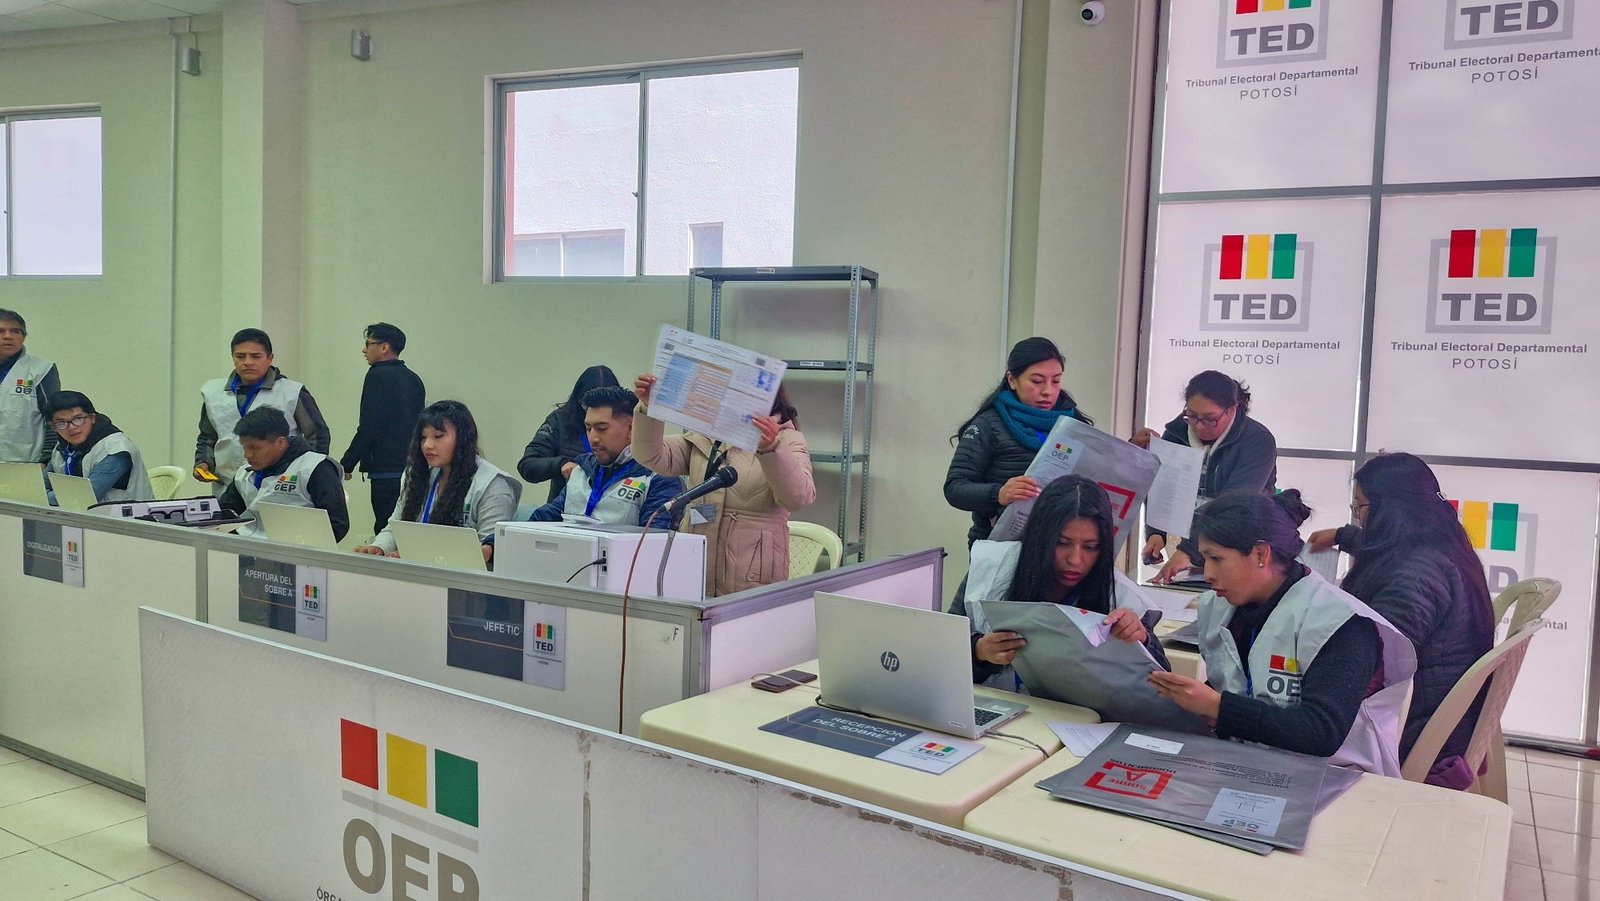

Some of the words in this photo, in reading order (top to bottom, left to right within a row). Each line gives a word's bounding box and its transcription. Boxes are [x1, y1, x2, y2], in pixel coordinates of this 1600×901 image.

[1460, 0, 1559, 36] TED
[1230, 22, 1315, 55] TED
[1409, 58, 1456, 71] Tribunal
[1460, 54, 1513, 67] Electoral
[1186, 76, 1227, 88] Tribunal
[1230, 72, 1276, 84] Electoral
[1279, 66, 1359, 81] Departamental
[1471, 66, 1538, 83] POTOSÍ
[1240, 84, 1298, 100] POTOSÍ
[1213, 293, 1297, 320] TED
[1441, 293, 1538, 322] TED
[1169, 338, 1210, 348] Tribunal
[1213, 339, 1259, 349] Electoral
[1262, 339, 1341, 350] Departamental
[1391, 341, 1438, 351] Tribunal
[1441, 342, 1494, 352] Electoral
[1497, 342, 1588, 354] Departamental
[1222, 353, 1280, 365] POTOSÍ
[1452, 357, 1518, 370] POTOSÍ
[1051, 450, 1069, 461] OEP
[617, 487, 641, 501] OEP
[245, 569, 279, 583] APERTURA
[280, 575, 293, 586] DEL
[264, 584, 287, 596] SOBRE
[287, 589, 293, 597] A
[305, 600, 319, 610] TED
[484, 621, 505, 634] JEFE
[506, 624, 520, 636] TIC
[535, 640, 554, 652] TED
[881, 651, 900, 672] hp
[812, 718, 836, 729] DEL
[839, 725, 885, 740] SOBRE
[883, 735, 897, 743] A
[918, 747, 945, 757] TED
[343, 818, 480, 901] OEP
